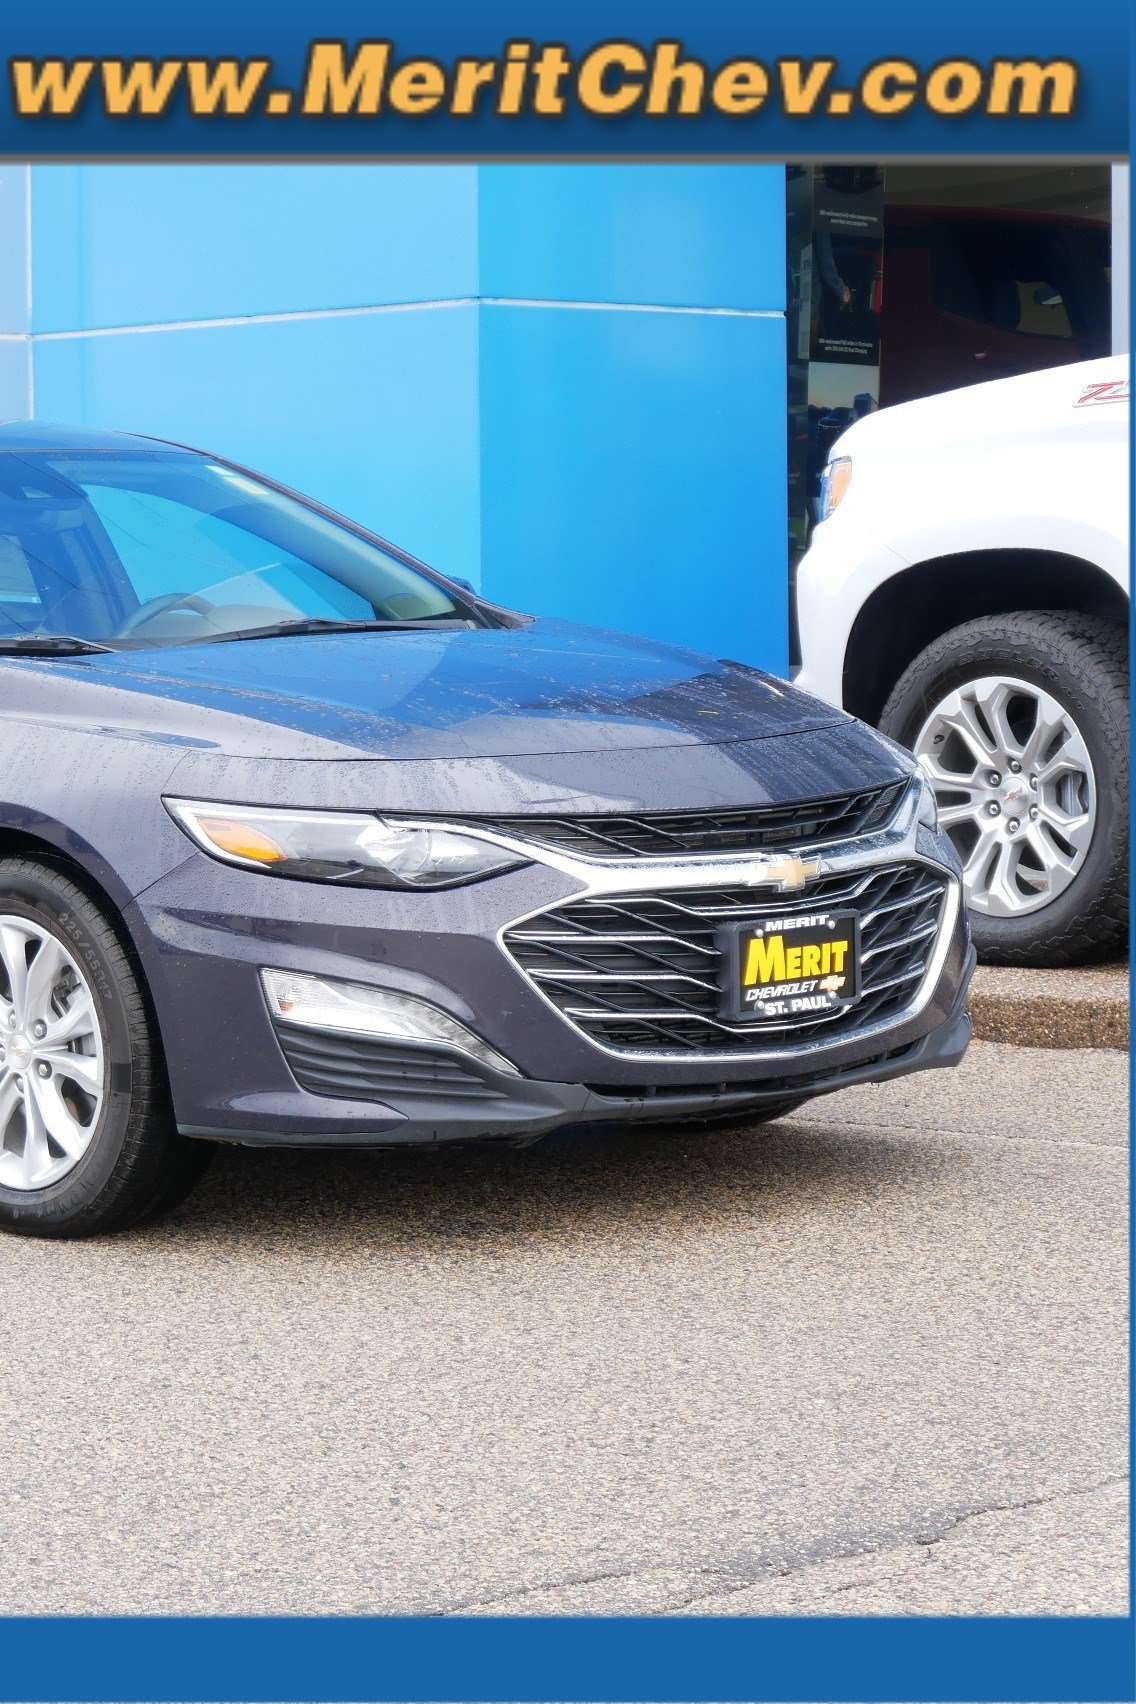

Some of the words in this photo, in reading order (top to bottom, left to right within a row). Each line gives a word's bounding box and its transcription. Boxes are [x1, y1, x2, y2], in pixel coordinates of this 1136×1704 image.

[765, 914, 830, 932] MERIT
[744, 935, 848, 986] MERIT
[745, 980, 819, 1002] CHEVROLET
[764, 1000, 789, 1016] ST.
[792, 995, 832, 1012] PAUL
